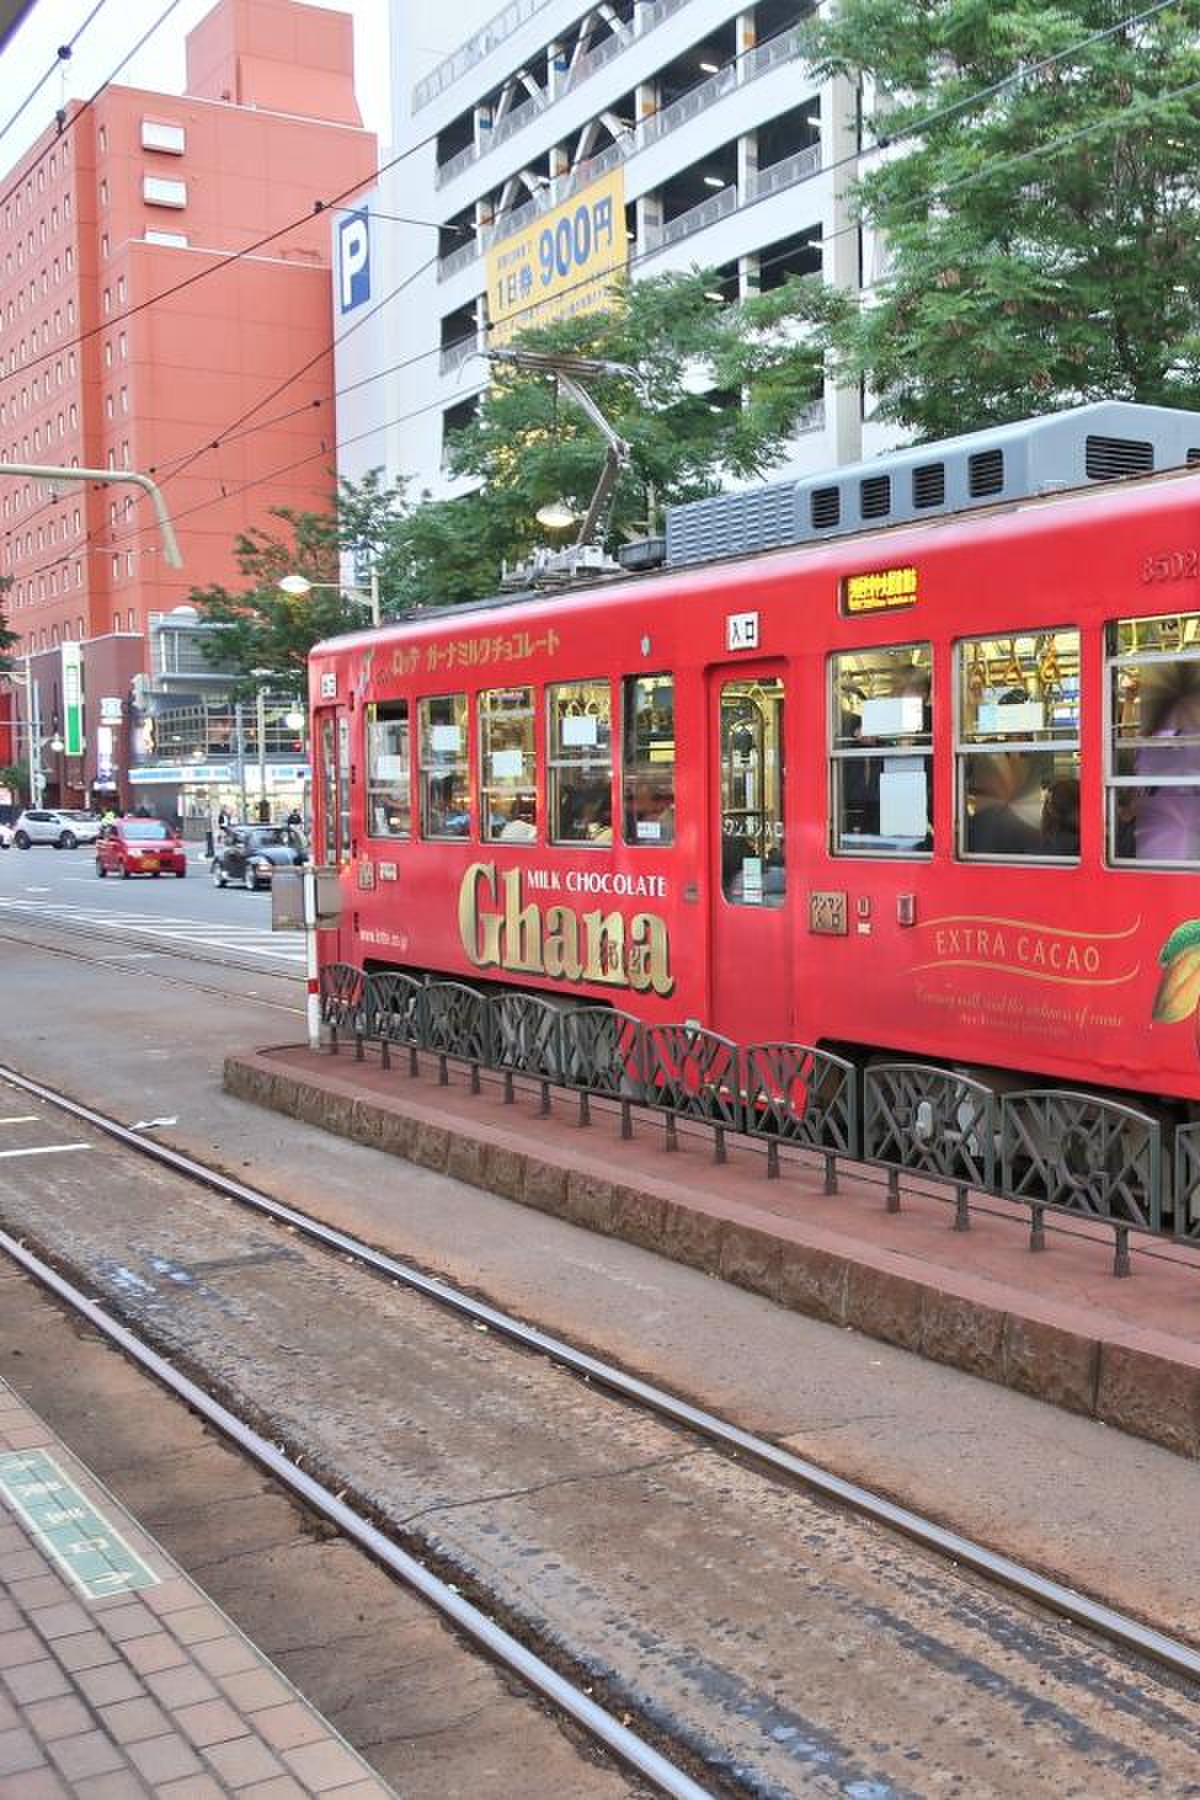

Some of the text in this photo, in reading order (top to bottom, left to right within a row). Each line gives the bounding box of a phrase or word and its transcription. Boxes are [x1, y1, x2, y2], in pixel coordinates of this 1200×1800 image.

[342, 219, 367, 306] P
[540, 195, 612, 286] 900円
[731, 619, 755, 642] 入口
[527, 869, 667, 898] MILK CHOCOLATE
[458, 861, 675, 997] Ghana
[936, 928, 1100, 973] EXTRA CACAO
